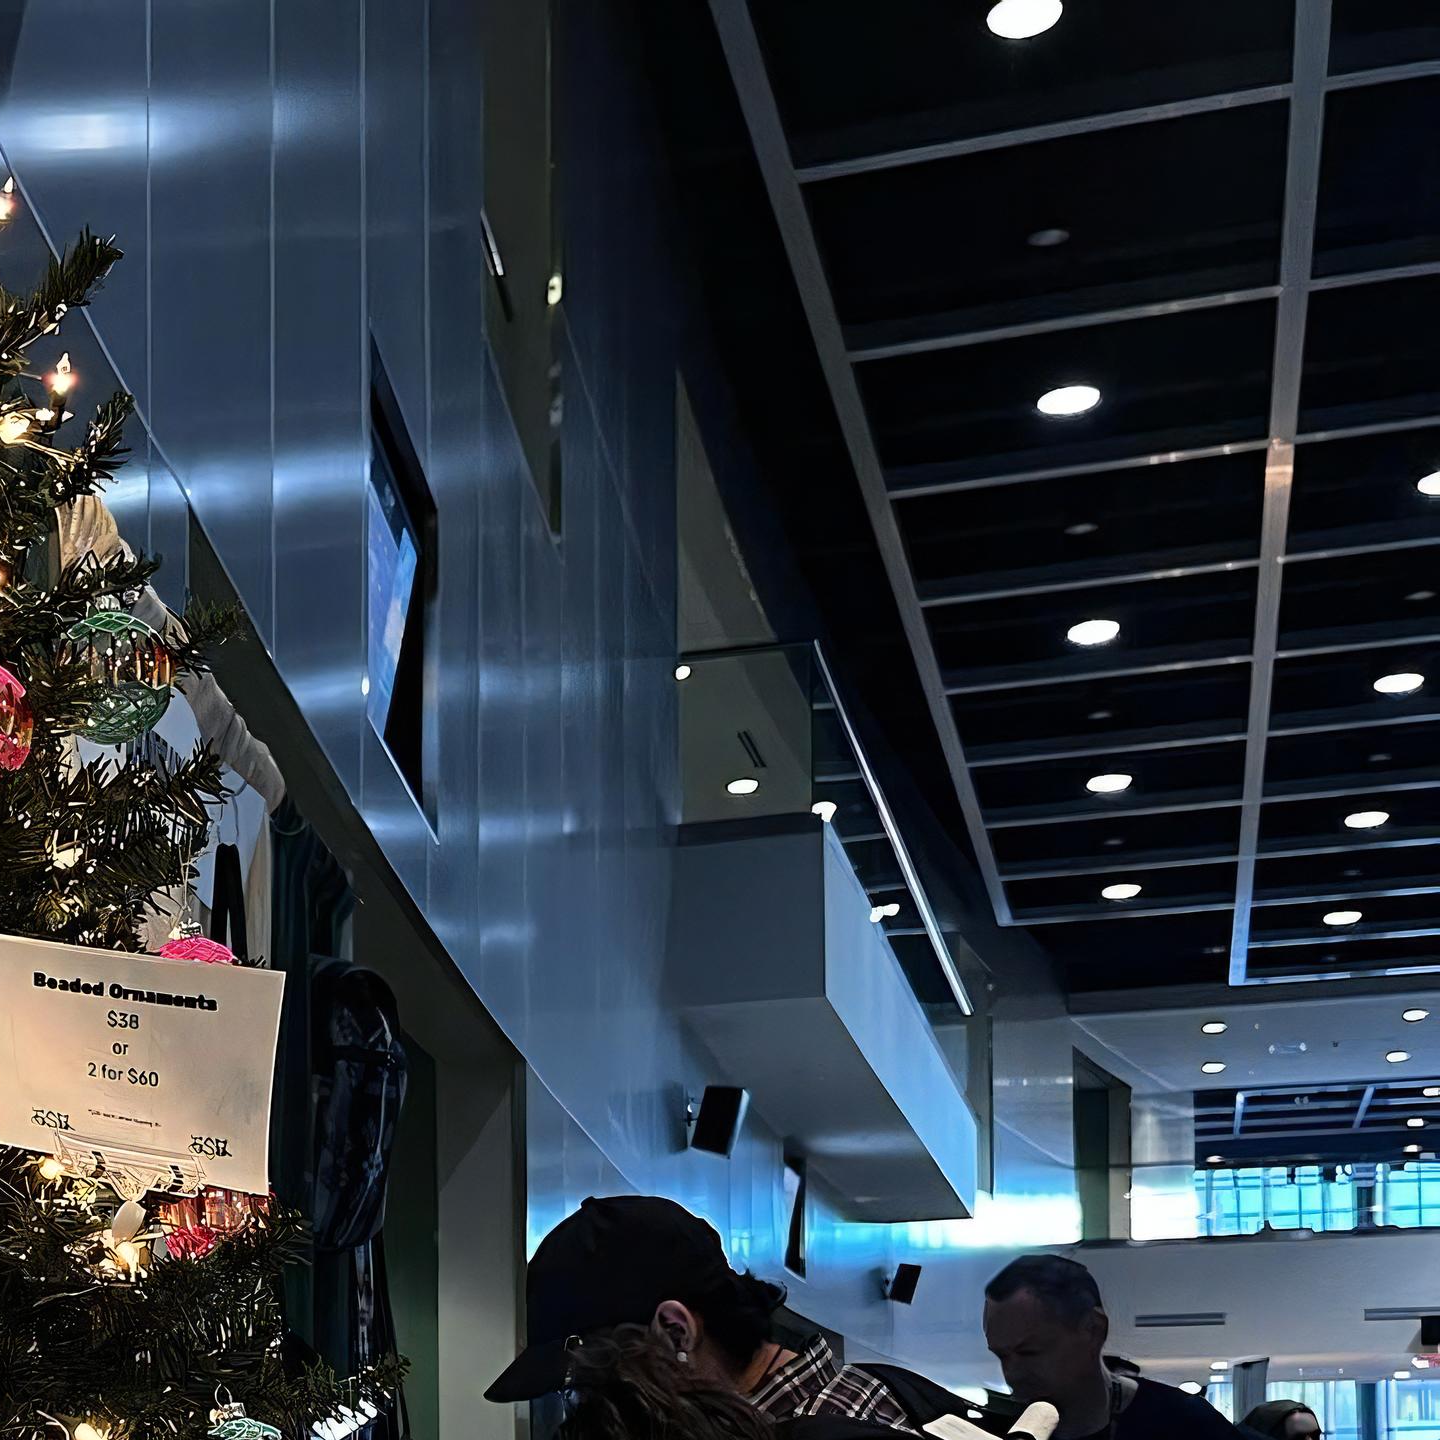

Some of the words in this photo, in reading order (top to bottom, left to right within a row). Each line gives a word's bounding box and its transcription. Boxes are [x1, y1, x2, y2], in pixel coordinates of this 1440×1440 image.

[33, 971, 105, 997] Beaded
[109, 983, 218, 1011] Ornaments
[107, 1010, 139, 1030] $38
[112, 1042, 128, 1056] or
[87, 1062, 97, 1078] 2
[101, 1064, 123, 1081] for
[127, 1068, 159, 1087] $60
